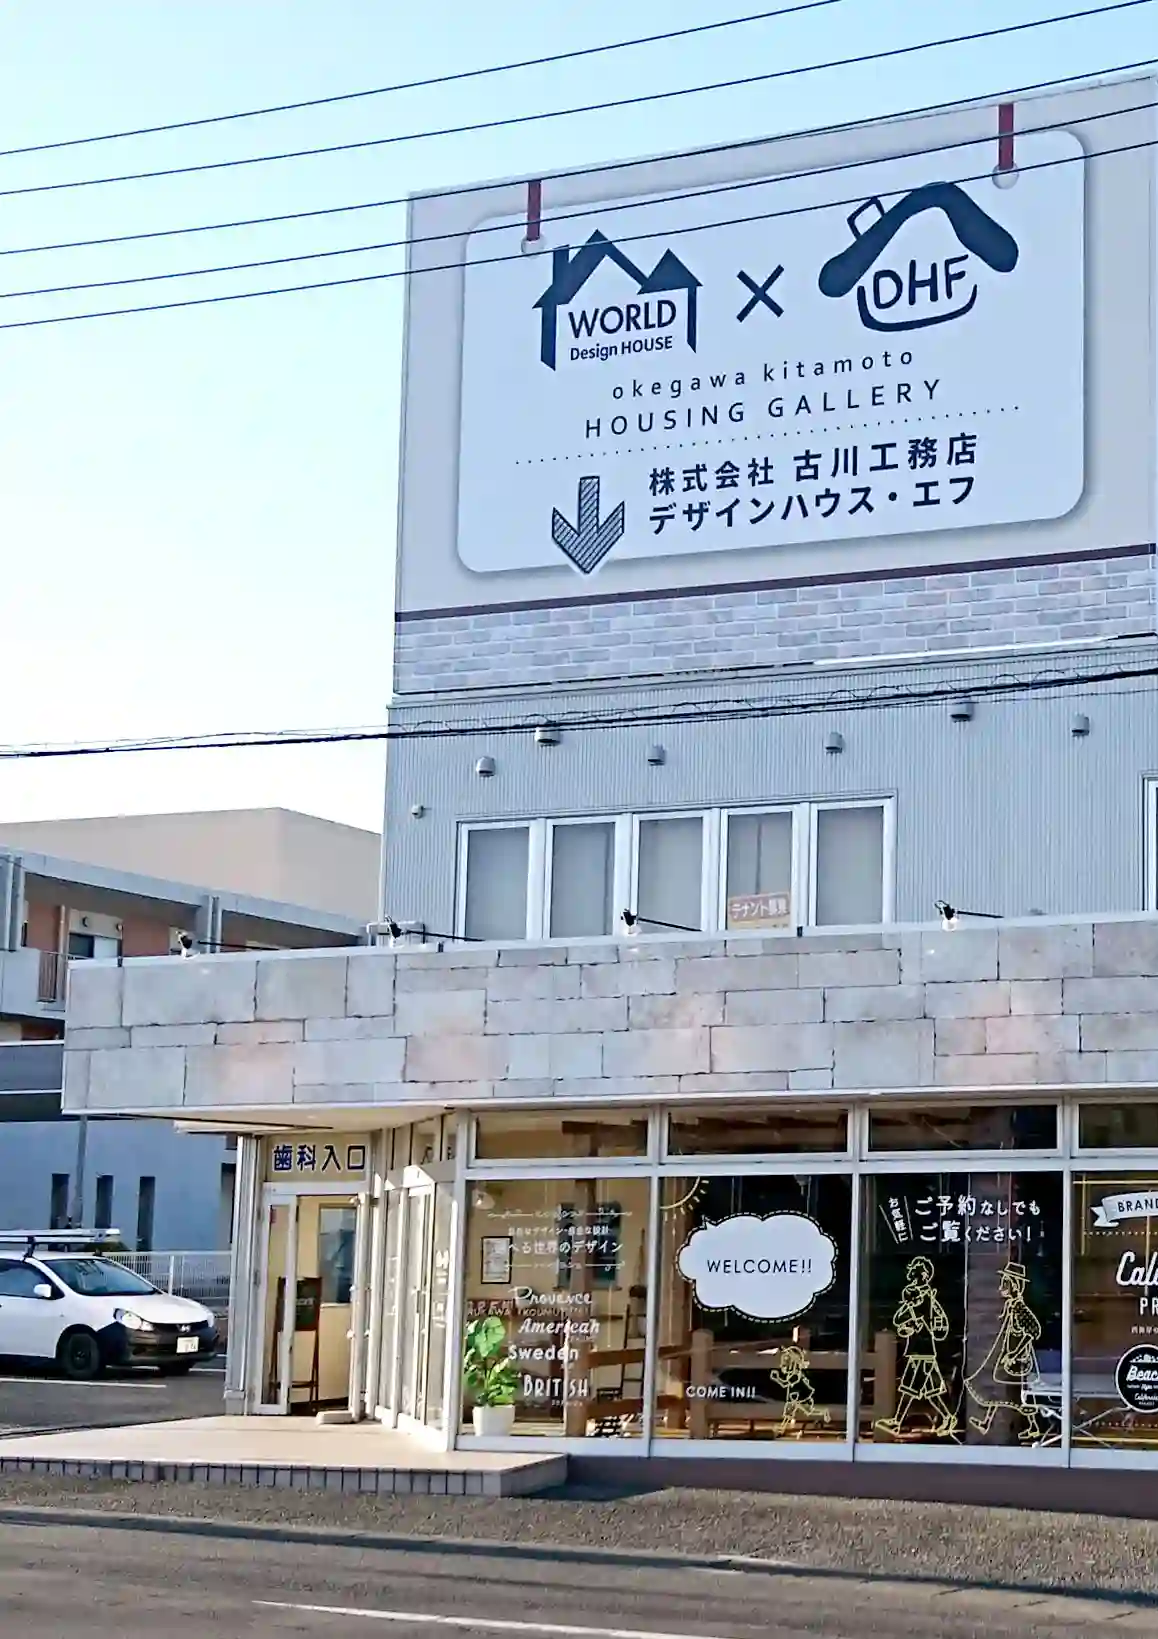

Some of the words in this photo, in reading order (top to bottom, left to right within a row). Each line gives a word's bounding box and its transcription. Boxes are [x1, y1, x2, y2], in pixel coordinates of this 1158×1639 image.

[872, 254, 969, 311] DHF
[568, 299, 677, 339] WORLD
[570, 344, 618, 362] Design
[621, 335, 673, 354] HOUSE
[612, 369, 746, 399] okegawa
[763, 350, 913, 383] kitamoto
[585, 402, 745, 438] HOUSING
[768, 379, 941, 418] GALLERY
[649, 456, 774, 497] 株式会社
[793, 432, 977, 483] 古川工務店
[649, 475, 976, 535] デザインハウス・エフ
[273, 1143, 366, 1172] 歯科入口
[915, 1194, 1041, 1217] ご予約なしでも
[706, 1258, 812, 1274] WELCOME!!
[508, 1286, 592, 1308] Provence
[518, 1317, 600, 1334] American
[508, 1345, 578, 1361] Sweden
[686, 1385, 726, 1399] COME
[730, 1386, 756, 1399] IN!!
